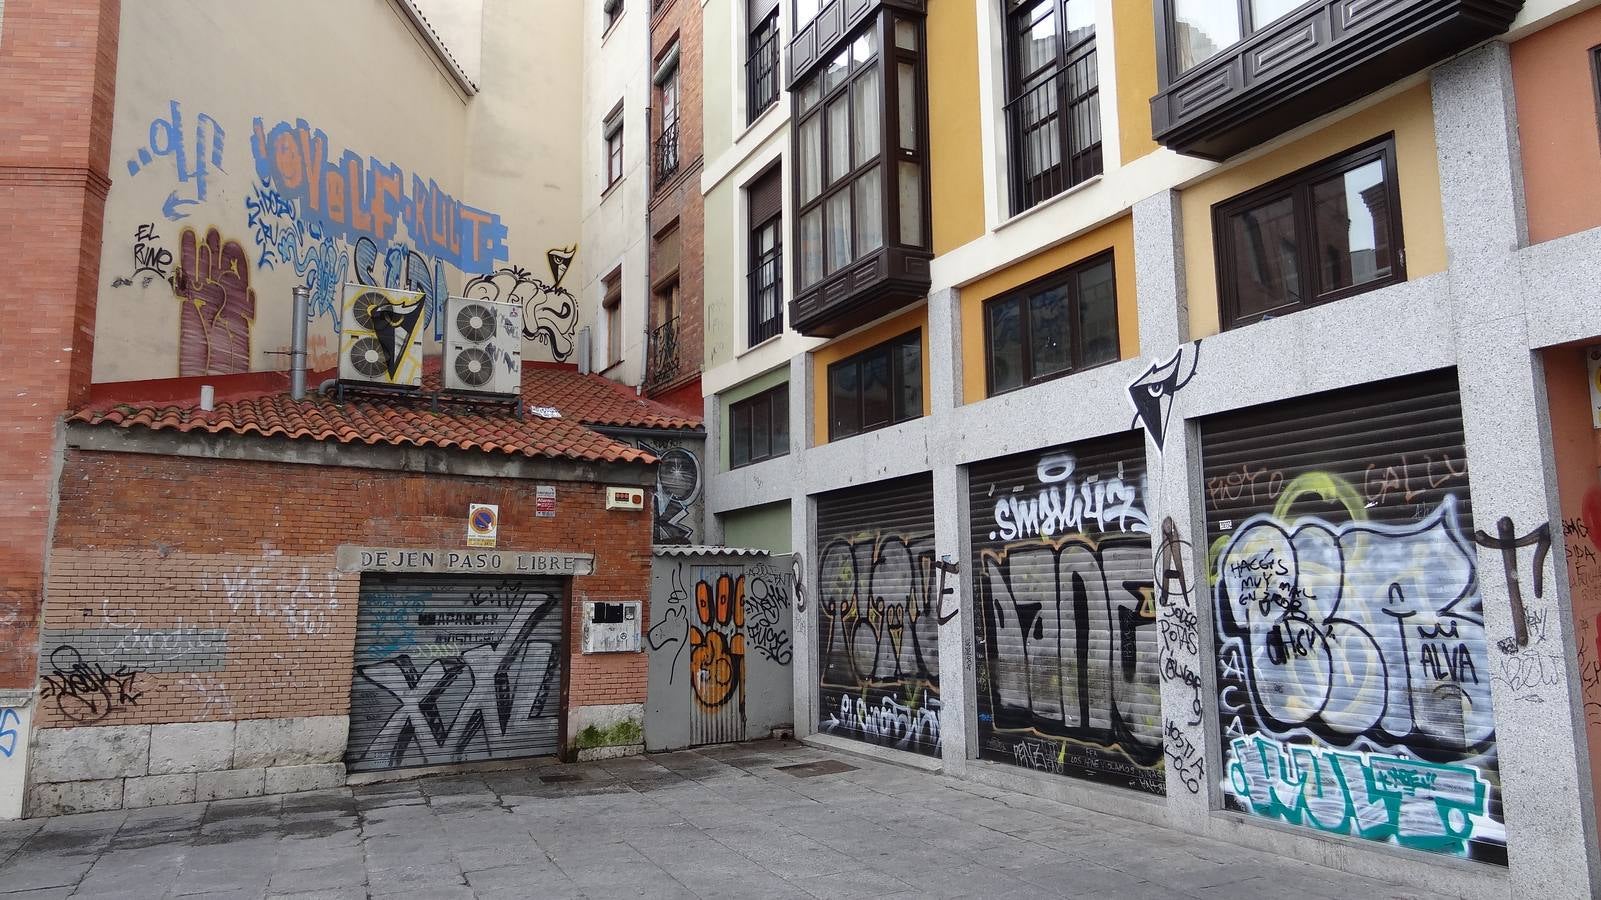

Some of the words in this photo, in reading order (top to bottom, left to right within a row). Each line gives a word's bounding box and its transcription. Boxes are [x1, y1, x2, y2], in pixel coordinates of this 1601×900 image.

[135, 223, 160, 242] EL
[361, 551, 434, 568] DEJEN
[448, 553, 501, 568] PASO
[516, 556, 574, 571] LIBRE
[1419, 643, 1479, 685] ALVA
